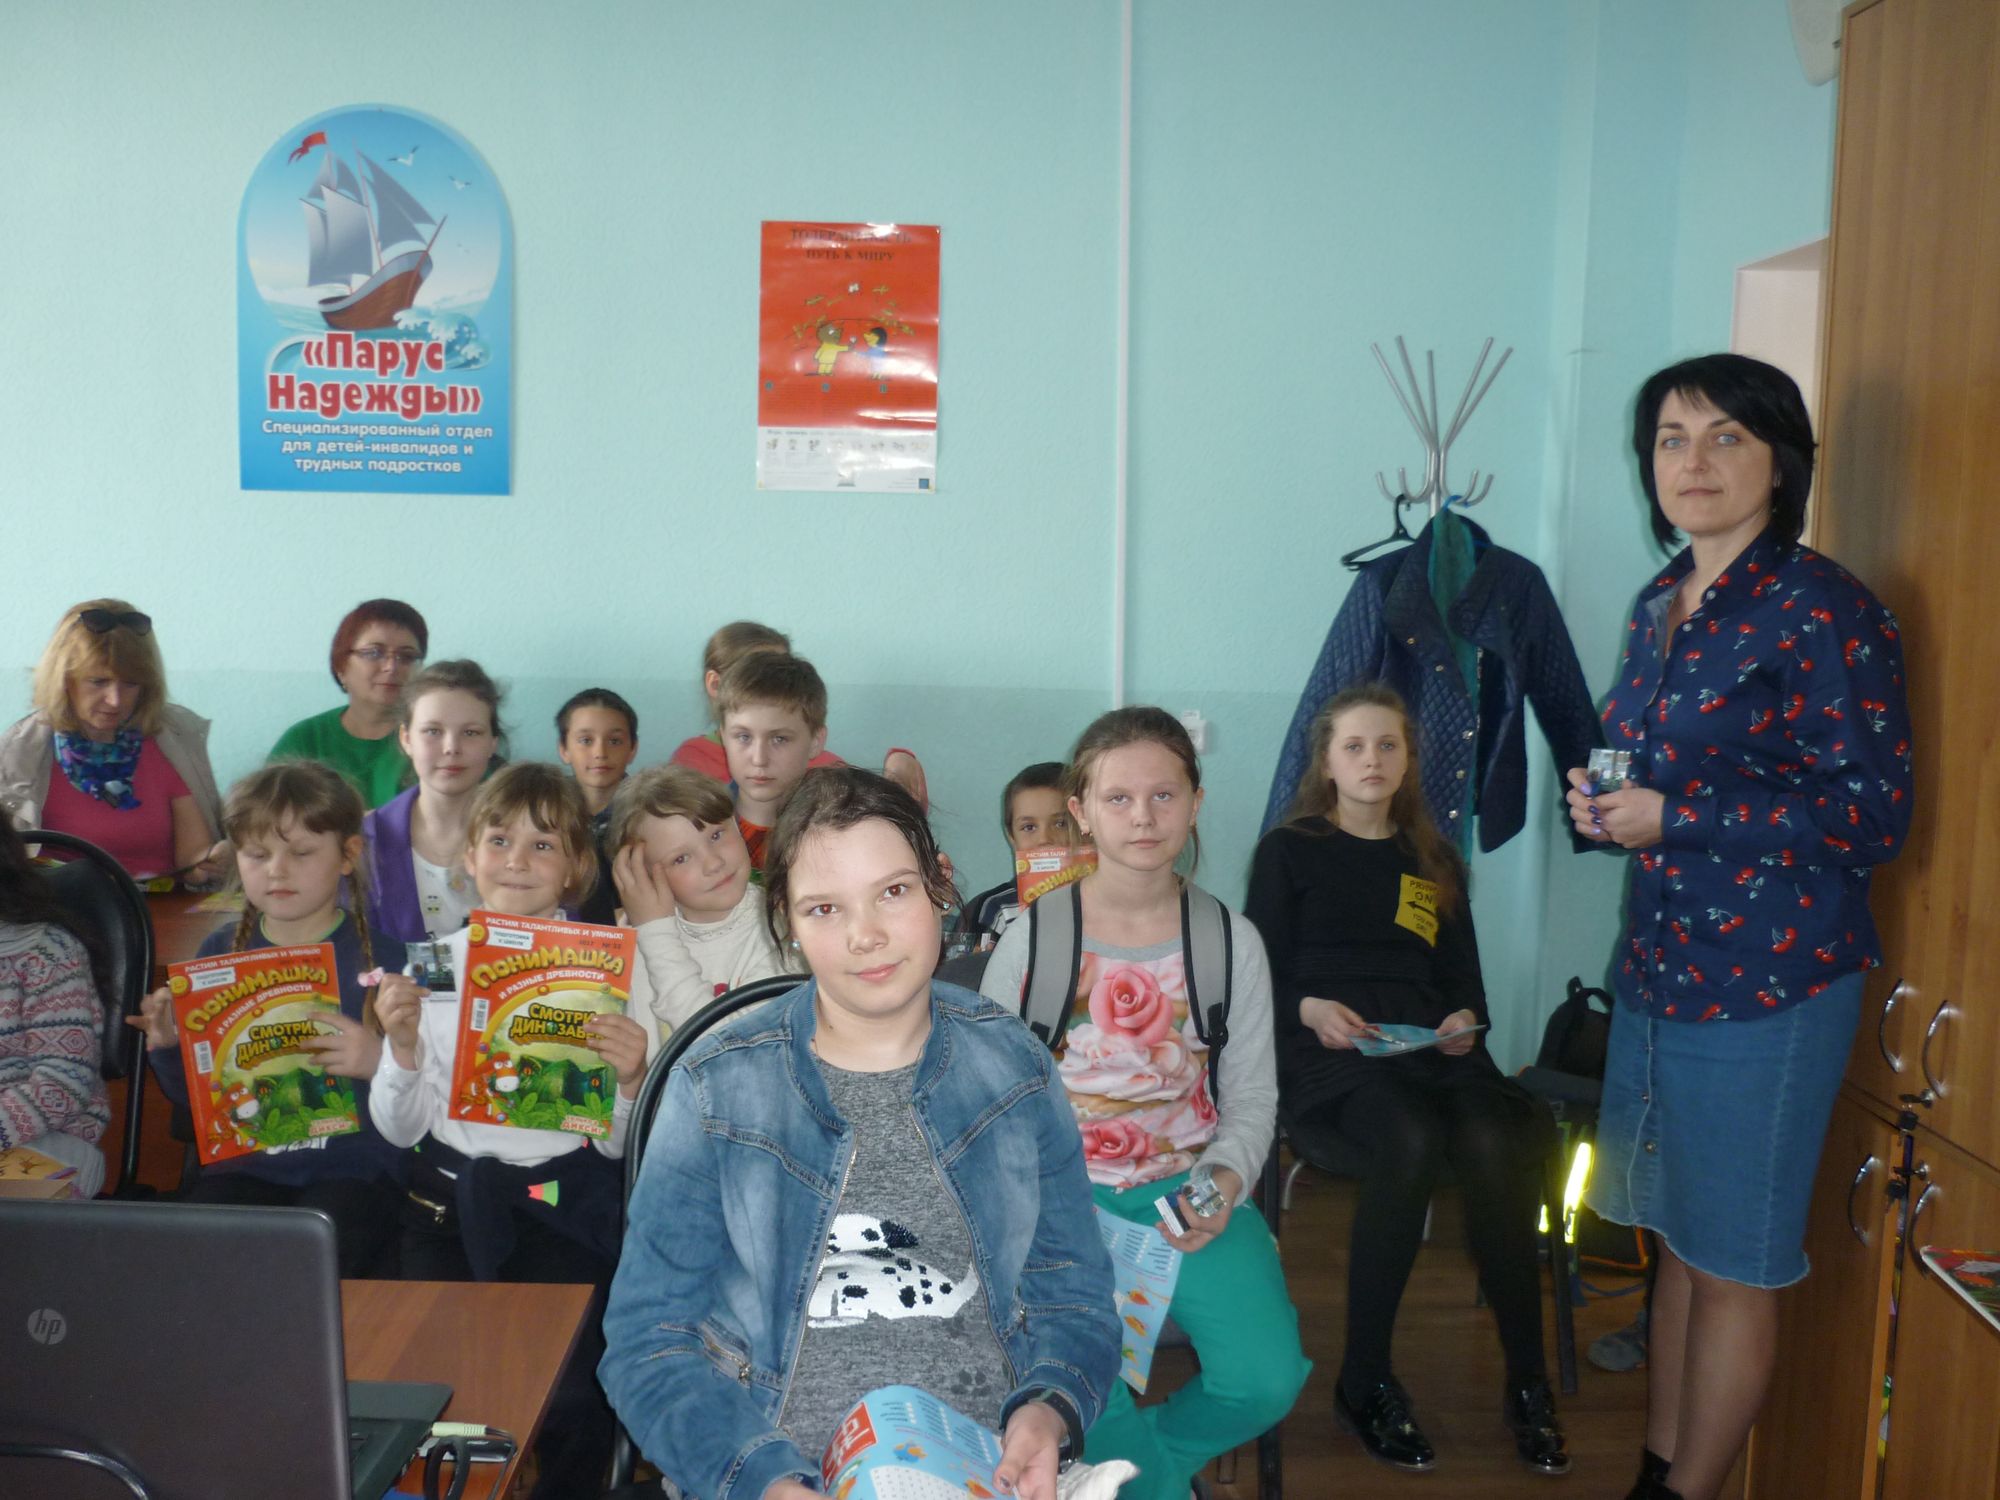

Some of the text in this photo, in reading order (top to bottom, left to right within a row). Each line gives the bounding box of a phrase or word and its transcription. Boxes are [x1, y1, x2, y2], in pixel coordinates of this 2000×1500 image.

[303, 332, 443, 377] «Парус
[267, 374, 482, 420] Надежды»
[262, 420, 493, 438] Специализированный отдел
[281, 440, 473, 456] для детей-инвалидов и
[294, 457, 461, 473] трудных подростков
[485, 917, 519, 929] РАСТИМ
[521, 920, 580, 936] ТАЛАНТЛИВЫХ
[185, 960, 218, 973] РАСТИМ
[220, 952, 280, 967] ТАЛАНТЛИВЫХ
[471, 945, 625, 990] ПОНИМАШКА
[508, 974, 544, 993] РАЗНЫЕ
[546, 969, 605, 981] ДРЕВНОСТИ
[184, 965, 329, 1033] ПОНИМАШКА
[222, 1000, 256, 1029] РАЗНЫЕ
[256, 984, 313, 1004] ДРЕВНОСТИ
[31, 1308, 64, 1345] hp
